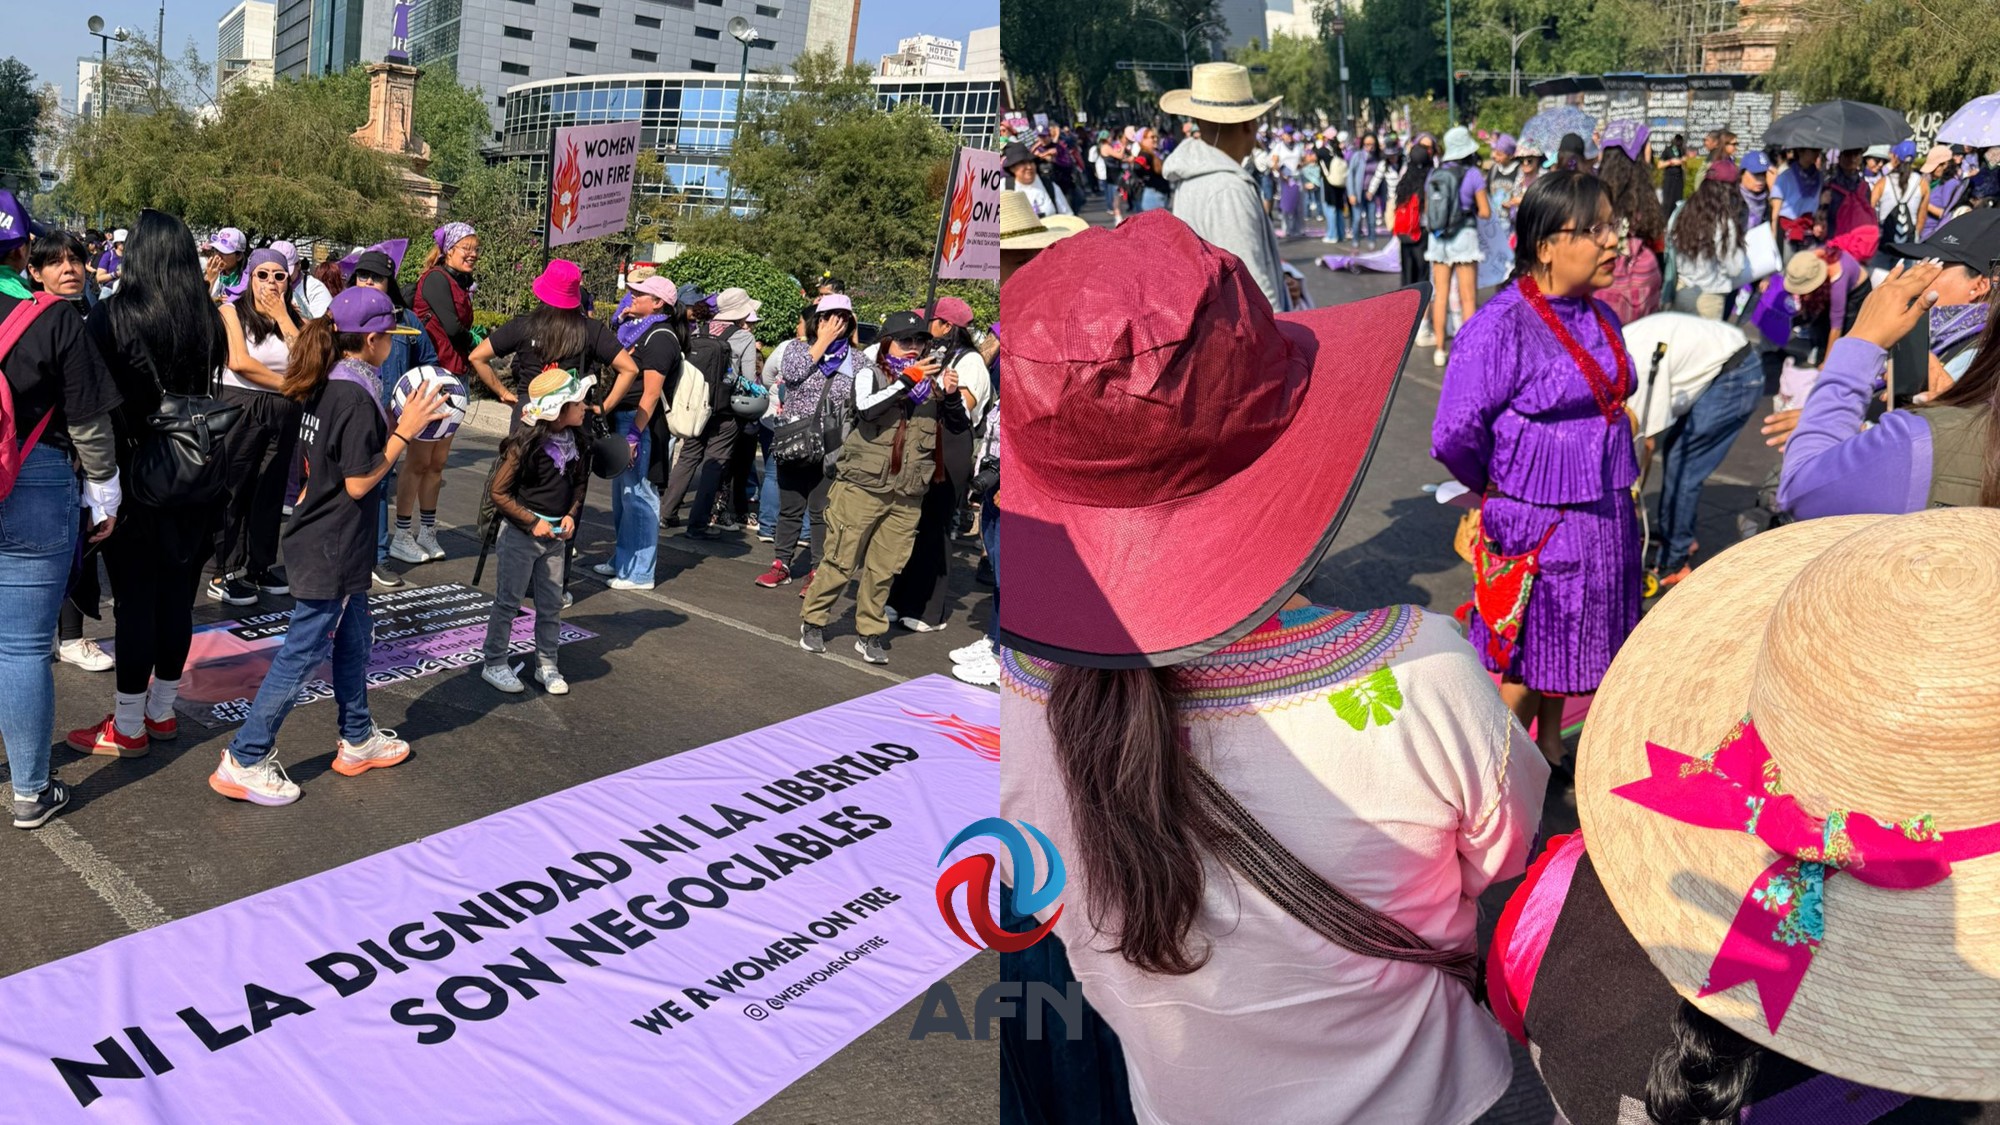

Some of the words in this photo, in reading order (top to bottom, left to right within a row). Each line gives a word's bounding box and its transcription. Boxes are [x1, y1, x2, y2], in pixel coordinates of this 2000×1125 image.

[929, 46, 954, 58] HOTEL
[585, 136, 635, 159] WOMEN
[582, 169, 603, 189] ON
[607, 164, 631, 186] FIRE
[980, 168, 1000, 191] WO
[972, 201, 992, 222] ON
[241, 609, 295, 626] LEOPO
[398, 584, 466, 599] HERRERA
[241, 629, 258, 638] 5
[258, 625, 289, 634] ten
[386, 591, 483, 612] feminicidio
[374, 617, 396, 627] or
[398, 615, 412, 623] y
[375, 627, 418, 641] udor
[419, 632, 449, 645] por
[452, 628, 468, 637] el
[388, 637, 485, 661] auoridades
[51, 1026, 174, 1108] NI
[176, 983, 316, 1052] LA
[305, 851, 632, 998] DIGNIDAD
[619, 814, 702, 864] NI
[688, 803, 766, 839] LA
[742, 742, 920, 814] LIBERTAD
[389, 947, 566, 1045] SON
[546, 805, 892, 968] NEGOCIABLES
[629, 999, 694, 1036] WE
[681, 988, 721, 1010] R
[705, 931, 819, 994] WOMEN
[808, 910, 857, 939] ON
[842, 886, 902, 919] FIRE
[765, 935, 889, 1011] @WERWOMENONFIRE
